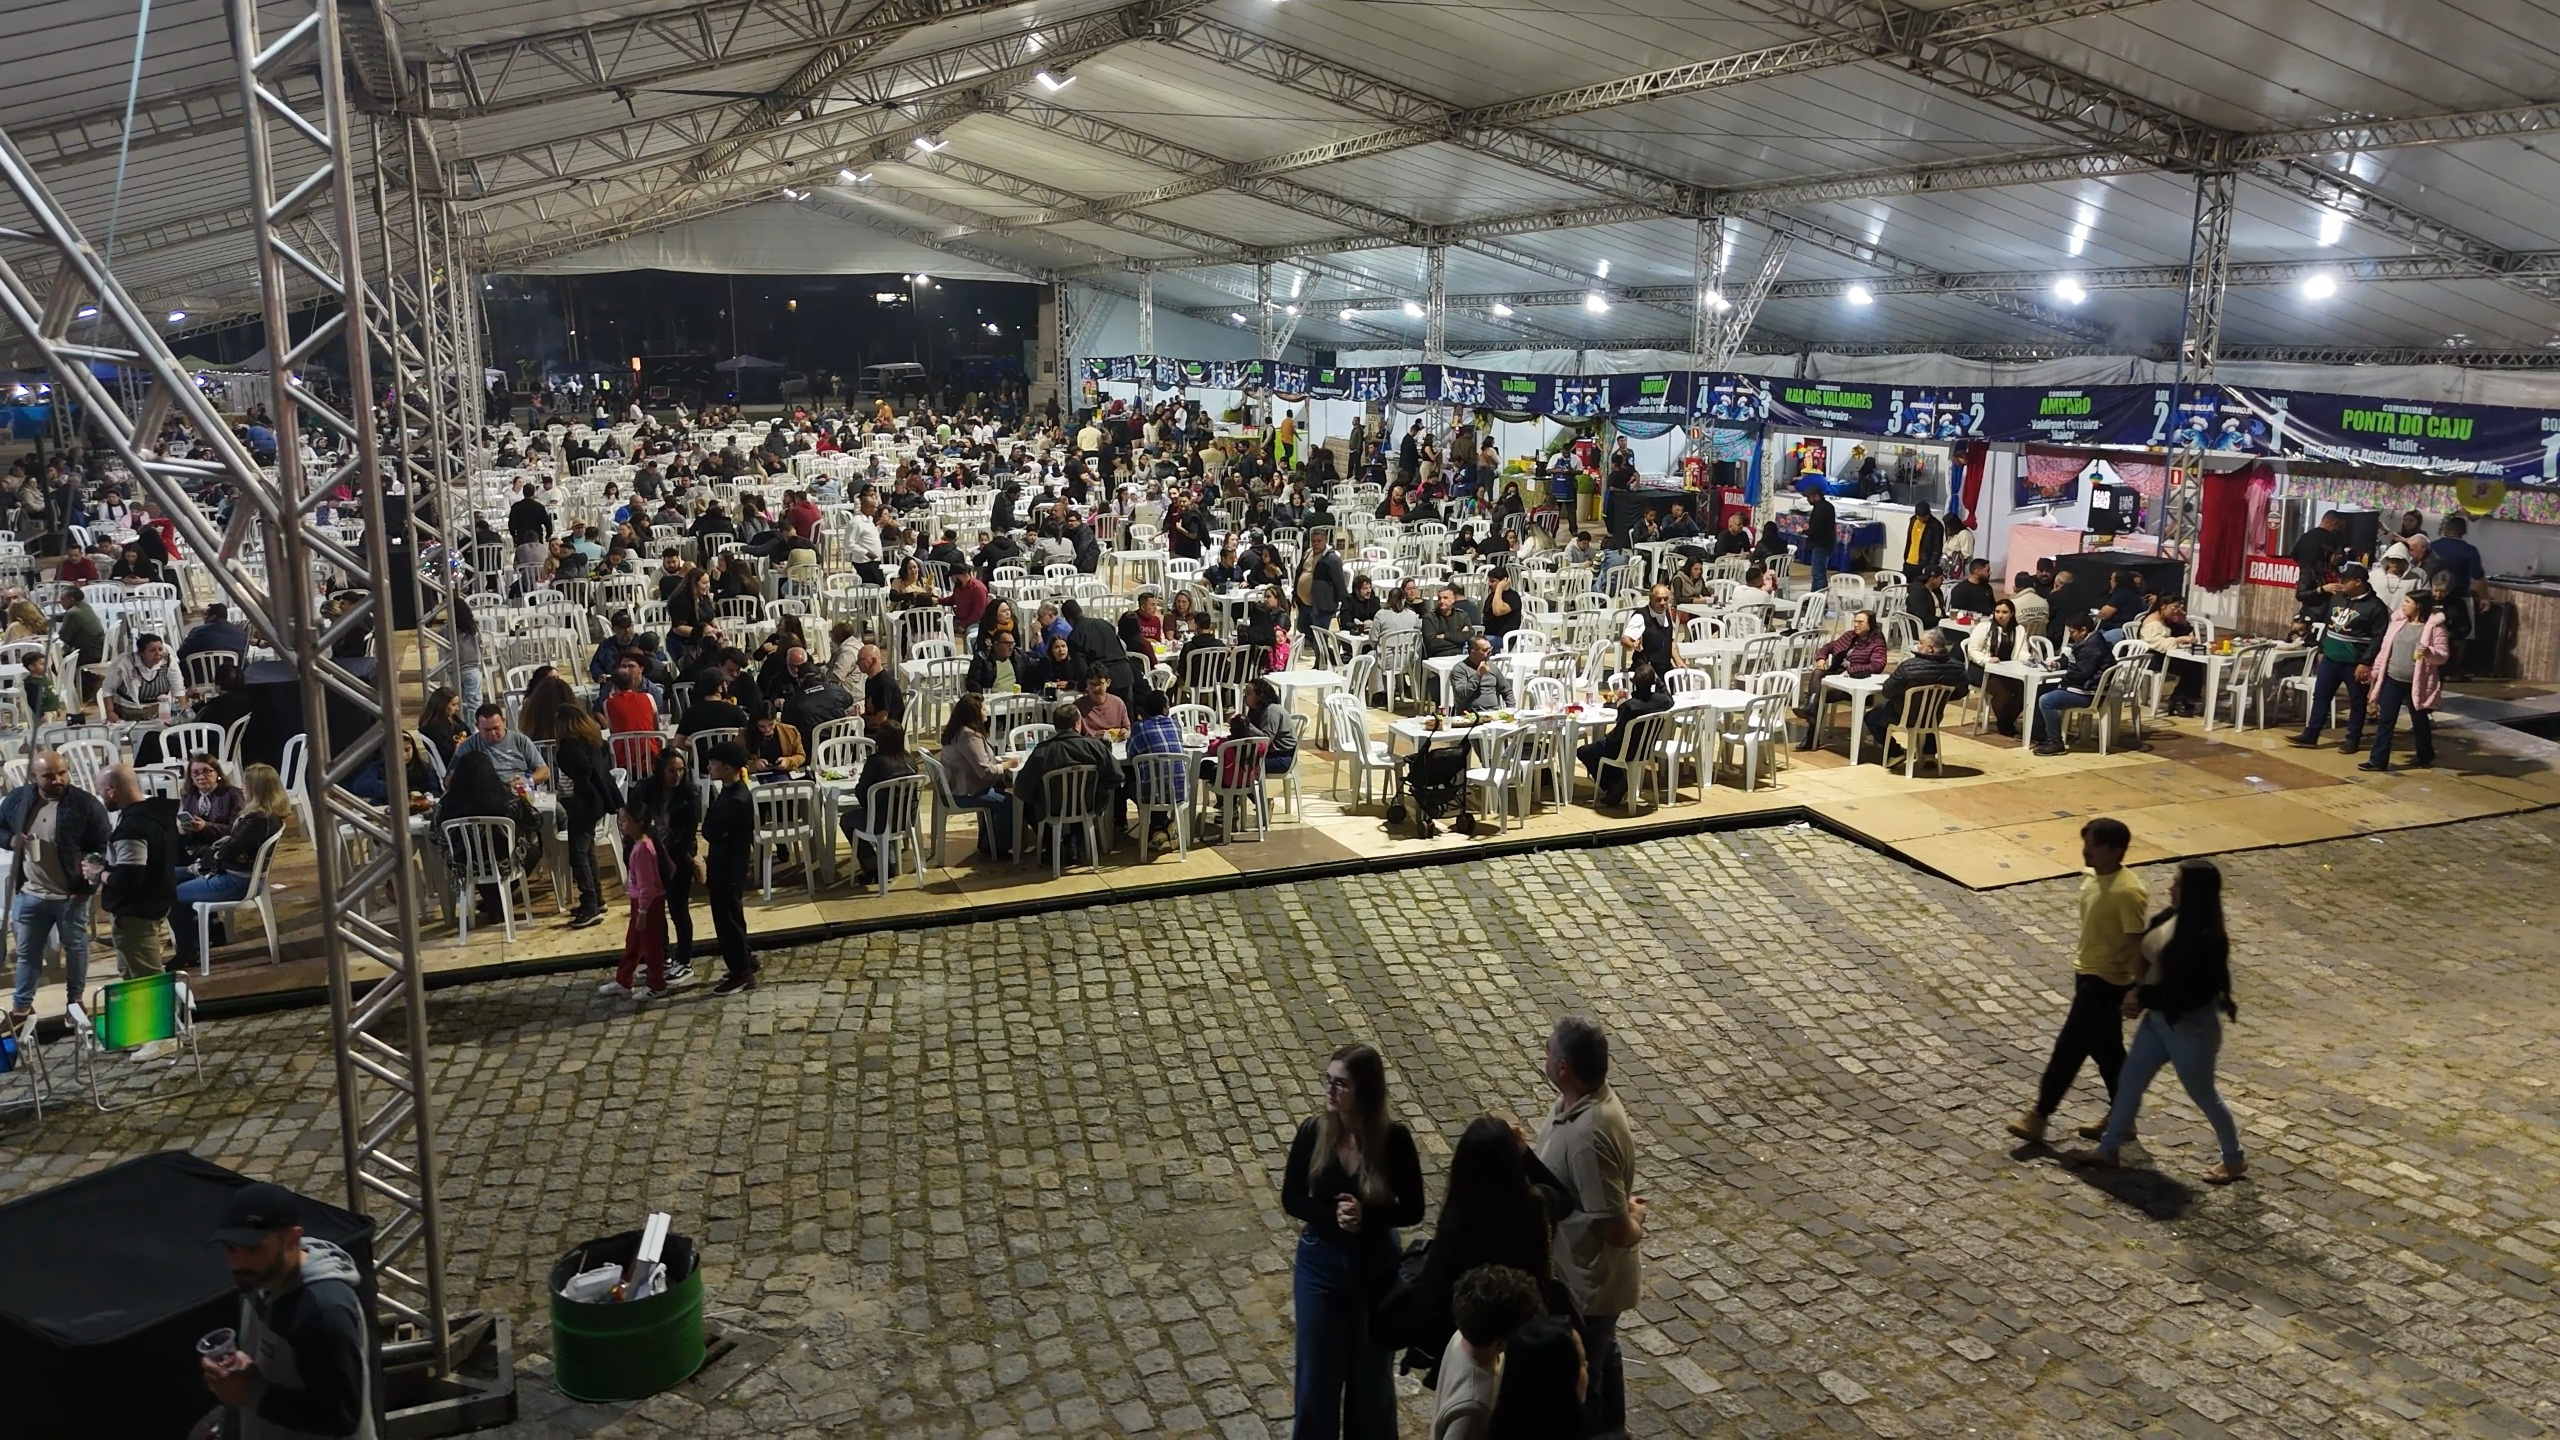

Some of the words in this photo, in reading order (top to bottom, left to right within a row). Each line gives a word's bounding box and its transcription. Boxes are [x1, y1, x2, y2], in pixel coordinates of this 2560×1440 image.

[1554, 386, 1564, 412] 5
[1600, 387, 1611, 413] 4
[1696, 385, 1708, 413] 4
[1758, 389, 1773, 419] 3
[1785, 387, 1804, 403] ILHA
[1805, 389, 1822, 405] DOS
[1823, 390, 1873, 409] VALADARES
[1971, 392, 1985, 403] BOX
[2039, 396, 2091, 415] AMPARO
[2155, 389, 2170, 402] BOX
[2270, 396, 2289, 410] BOX
[1887, 400, 1904, 434] 3
[1968, 403, 1985, 437] 2
[2153, 402, 2170, 441] 2
[2382, 404, 2433, 416] COMUNIDADE
[2269, 408, 2288, 451] 1
[2342, 408, 2396, 434] PONTA
[2399, 414, 2422, 437] DO
[2427, 416, 2474, 441] CAJU
[2541, 417, 2560, 431] BO
[2388, 438, 2418, 453] Nadir
[2540, 432, 2560, 478] 1
[2361, 448, 2429, 468] Restaurante
[2478, 460, 2504, 475] Dias
[2249, 561, 2300, 584] BRAHMA
